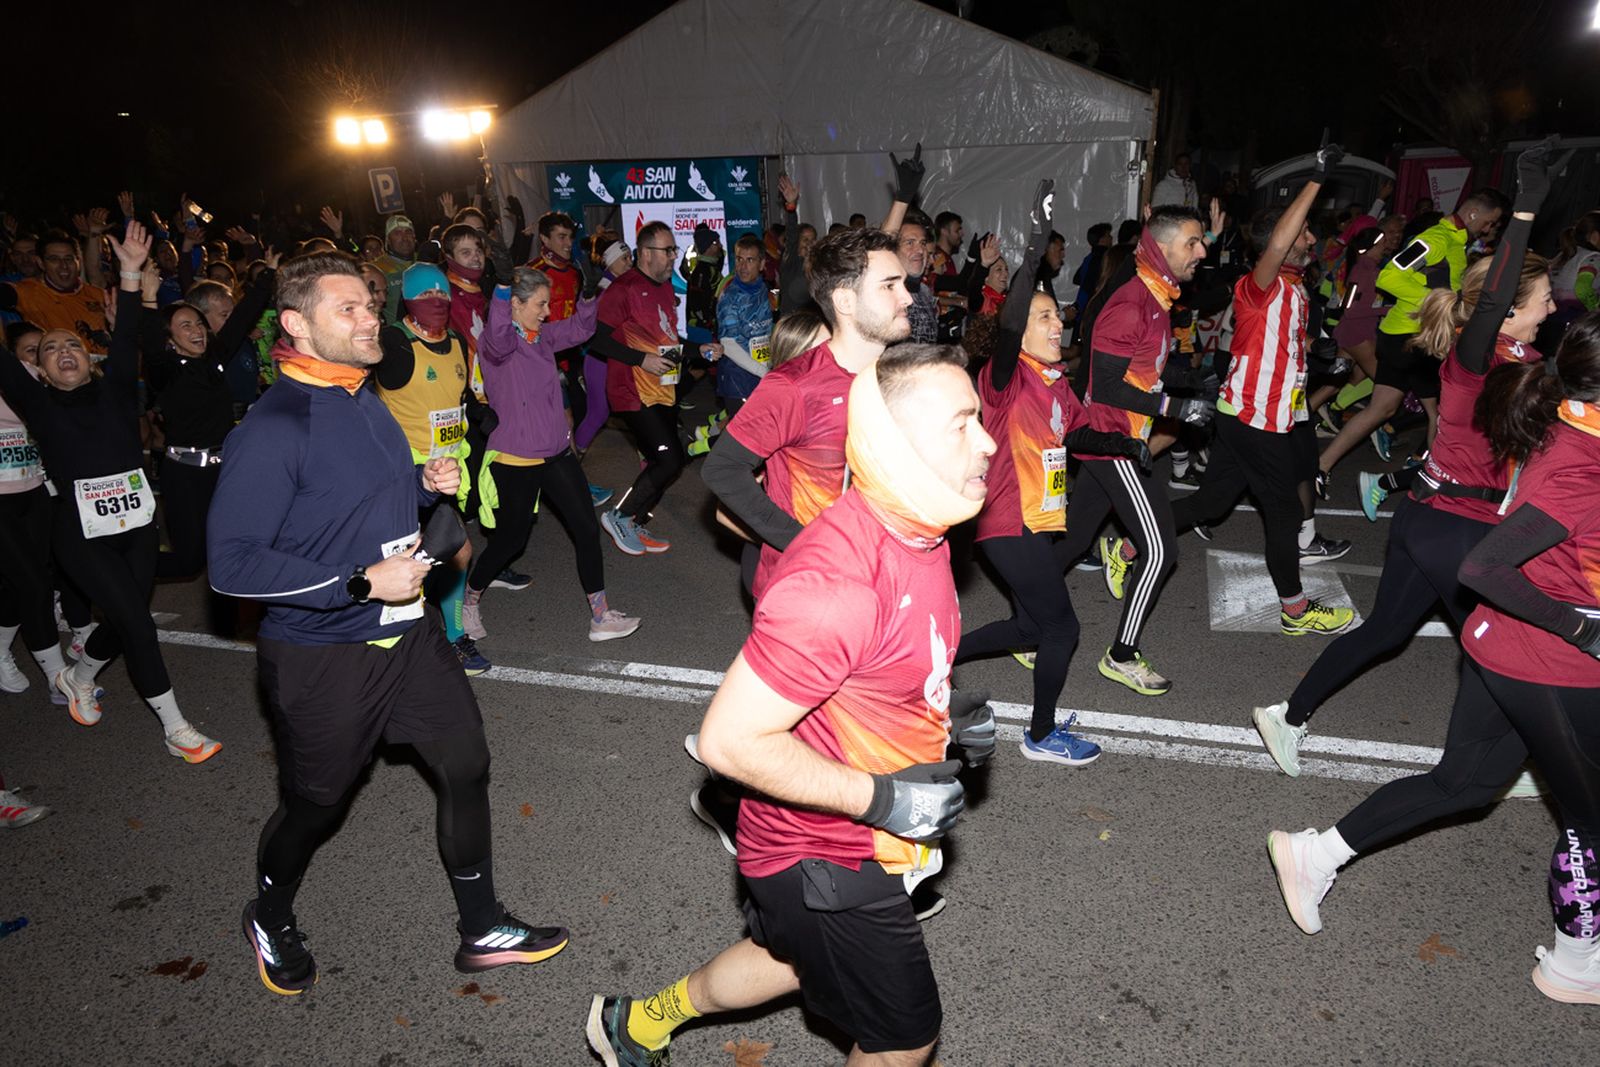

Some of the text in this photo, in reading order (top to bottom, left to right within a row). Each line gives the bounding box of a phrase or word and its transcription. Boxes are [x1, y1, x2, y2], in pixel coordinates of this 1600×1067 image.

[626, 166, 677, 185] 43 SAN
[376, 174, 395, 208] P
[624, 180, 676, 200] ANTÓN
[674, 219, 698, 231] SAN
[92, 480, 125, 492] NOCHE DE
[84, 491, 101, 501] SAN
[94, 491, 142, 517] 6315
[1566, 828, 1588, 891] UNDER
